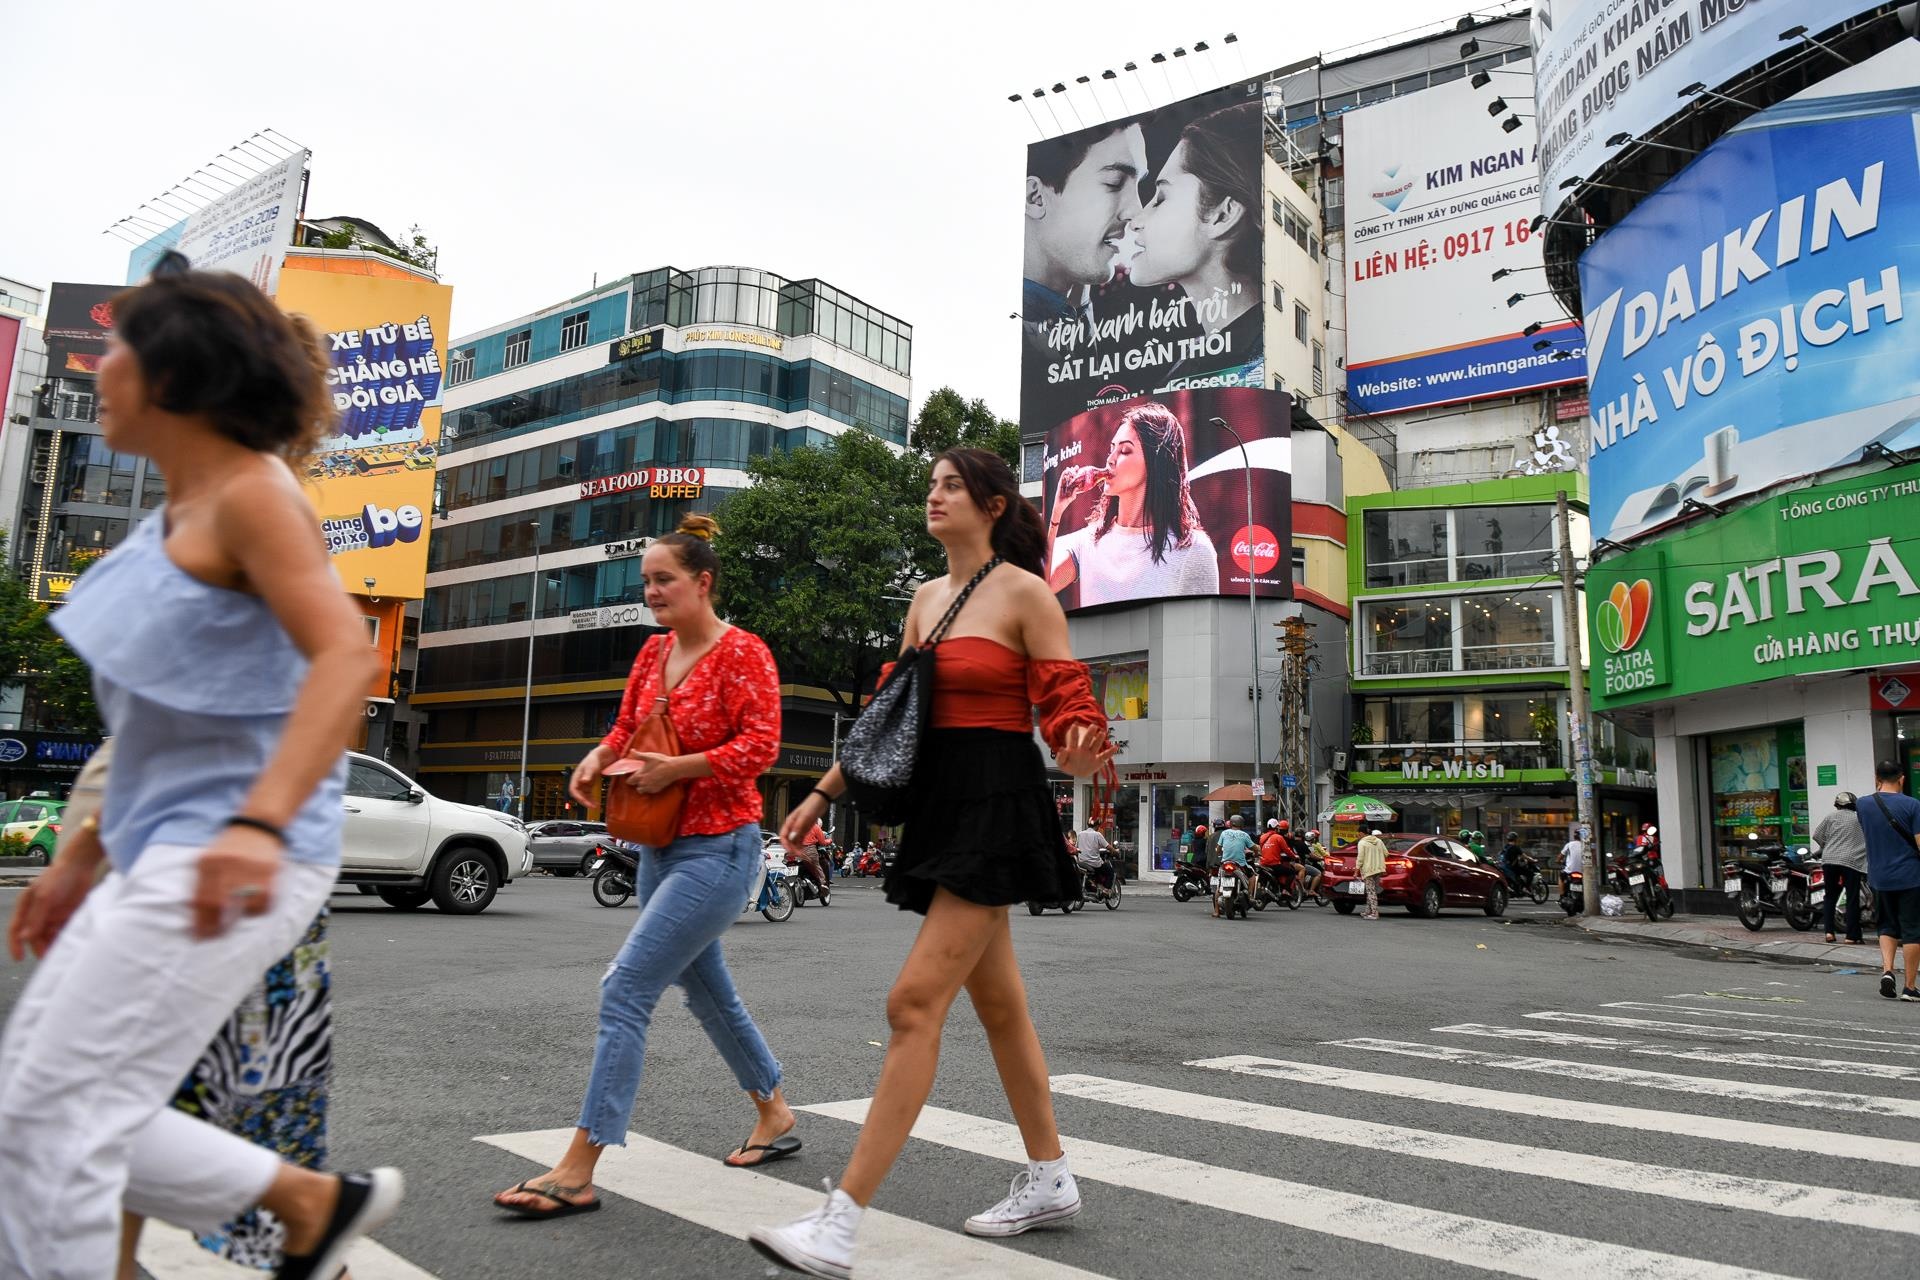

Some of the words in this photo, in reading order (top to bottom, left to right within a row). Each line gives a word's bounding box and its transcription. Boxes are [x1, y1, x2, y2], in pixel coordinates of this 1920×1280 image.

[1582, 59, 1631, 123] ĐƯỢC
[1636, 11, 1691, 77] NẤM
[1426, 164, 1463, 191] KIM
[1470, 147, 1524, 179] NGAN
[1353, 222, 1381, 240] CÔNG
[1382, 221, 1395, 233] TY
[1397, 212, 1425, 228] TNHH
[1427, 206, 1447, 222] XÂY
[1449, 197, 1479, 215] DỰNG
[1481, 190, 1517, 207] QUẢNG
[1354, 250, 1398, 282] LIÊN
[1404, 238, 1438, 271] HỆ:
[1443, 226, 1495, 260] 0917
[1622, 160, 1885, 359] DAIKIN
[707, 329, 723, 341] KIM
[723, 330, 748, 343] LONG
[748, 333, 783, 351] BUILDING
[1087, 302, 1144, 348] xanh
[1149, 297, 1194, 333] bật
[327, 330, 362, 351] XE
[1047, 353, 1084, 384] SÁT
[1088, 351, 1120, 381] LẠI
[1124, 337, 1174, 371] GẦN
[1177, 326, 1232, 361] THÔI
[1589, 371, 1659, 459] NHÀ
[1662, 331, 1727, 410] VÔ
[1736, 264, 1904, 378] ĐỊCH
[333, 385, 379, 413] ĐỘI
[380, 379, 425, 405] GIÁ
[1357, 377, 1422, 398] Website:
[580, 470, 649, 498] SEAFOOD
[655, 468, 700, 485] BBQ
[650, 485, 703, 499] BUFFET
[1780, 500, 1823, 521] TỔNG
[1826, 490, 1868, 511] CÔNG
[1870, 486, 1889, 501] TY
[349, 533, 369, 544] xe
[363, 503, 422, 540] be
[1684, 536, 1920, 636] SATRA
[1604, 649, 1654, 675] SATRA
[1753, 633, 1785, 665] CỬA
[1787, 629, 1859, 658] HÀNG
[1605, 668, 1656, 694] FOODS
[1124, 773, 1129, 781] 2
